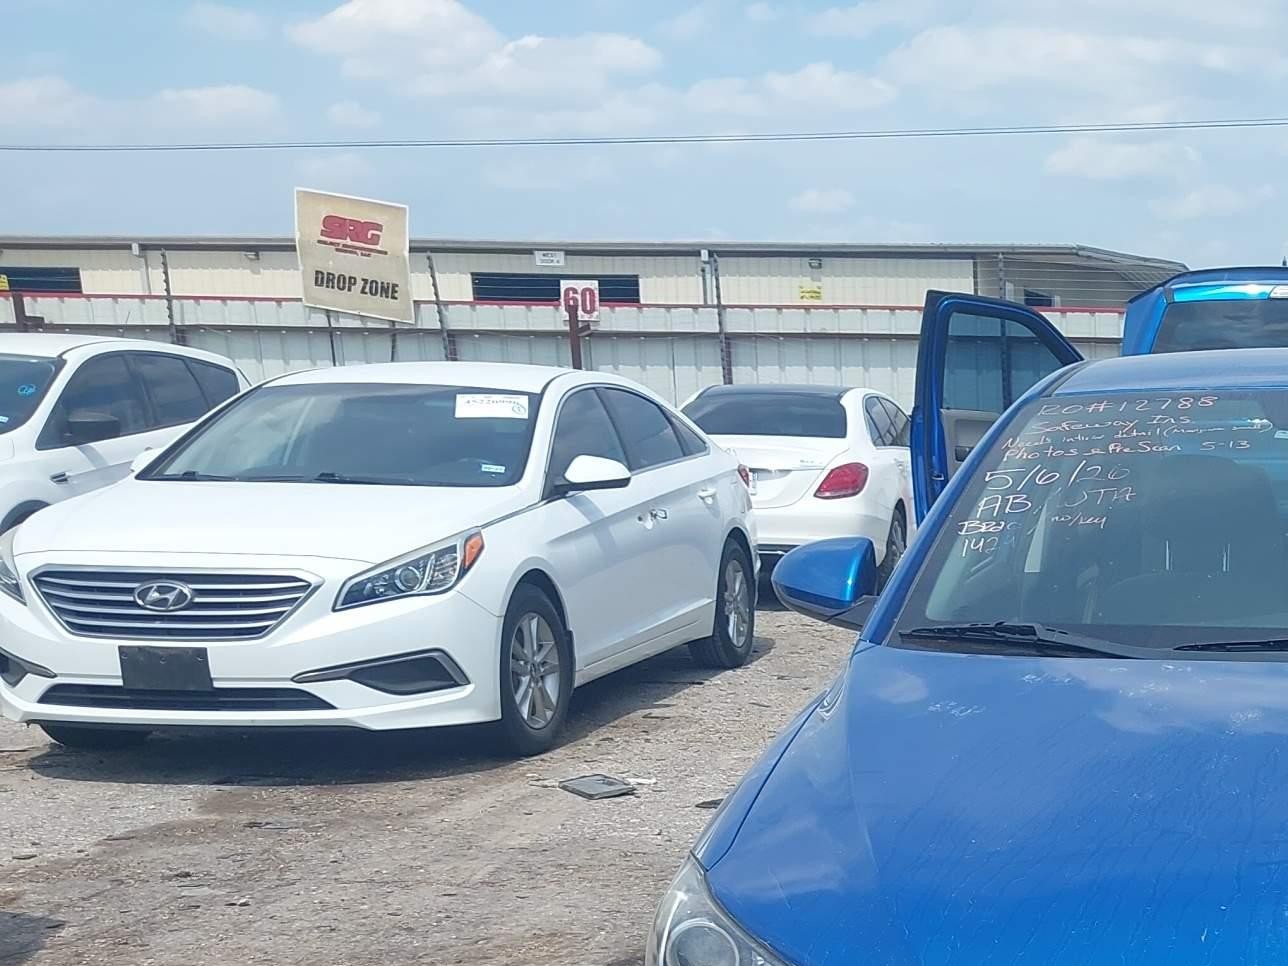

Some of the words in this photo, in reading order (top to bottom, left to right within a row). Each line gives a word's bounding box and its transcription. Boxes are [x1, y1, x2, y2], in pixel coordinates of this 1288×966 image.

[315, 269, 358, 292] DROP
[360, 277, 399, 300] ZONE
[563, 286, 596, 315] 60
